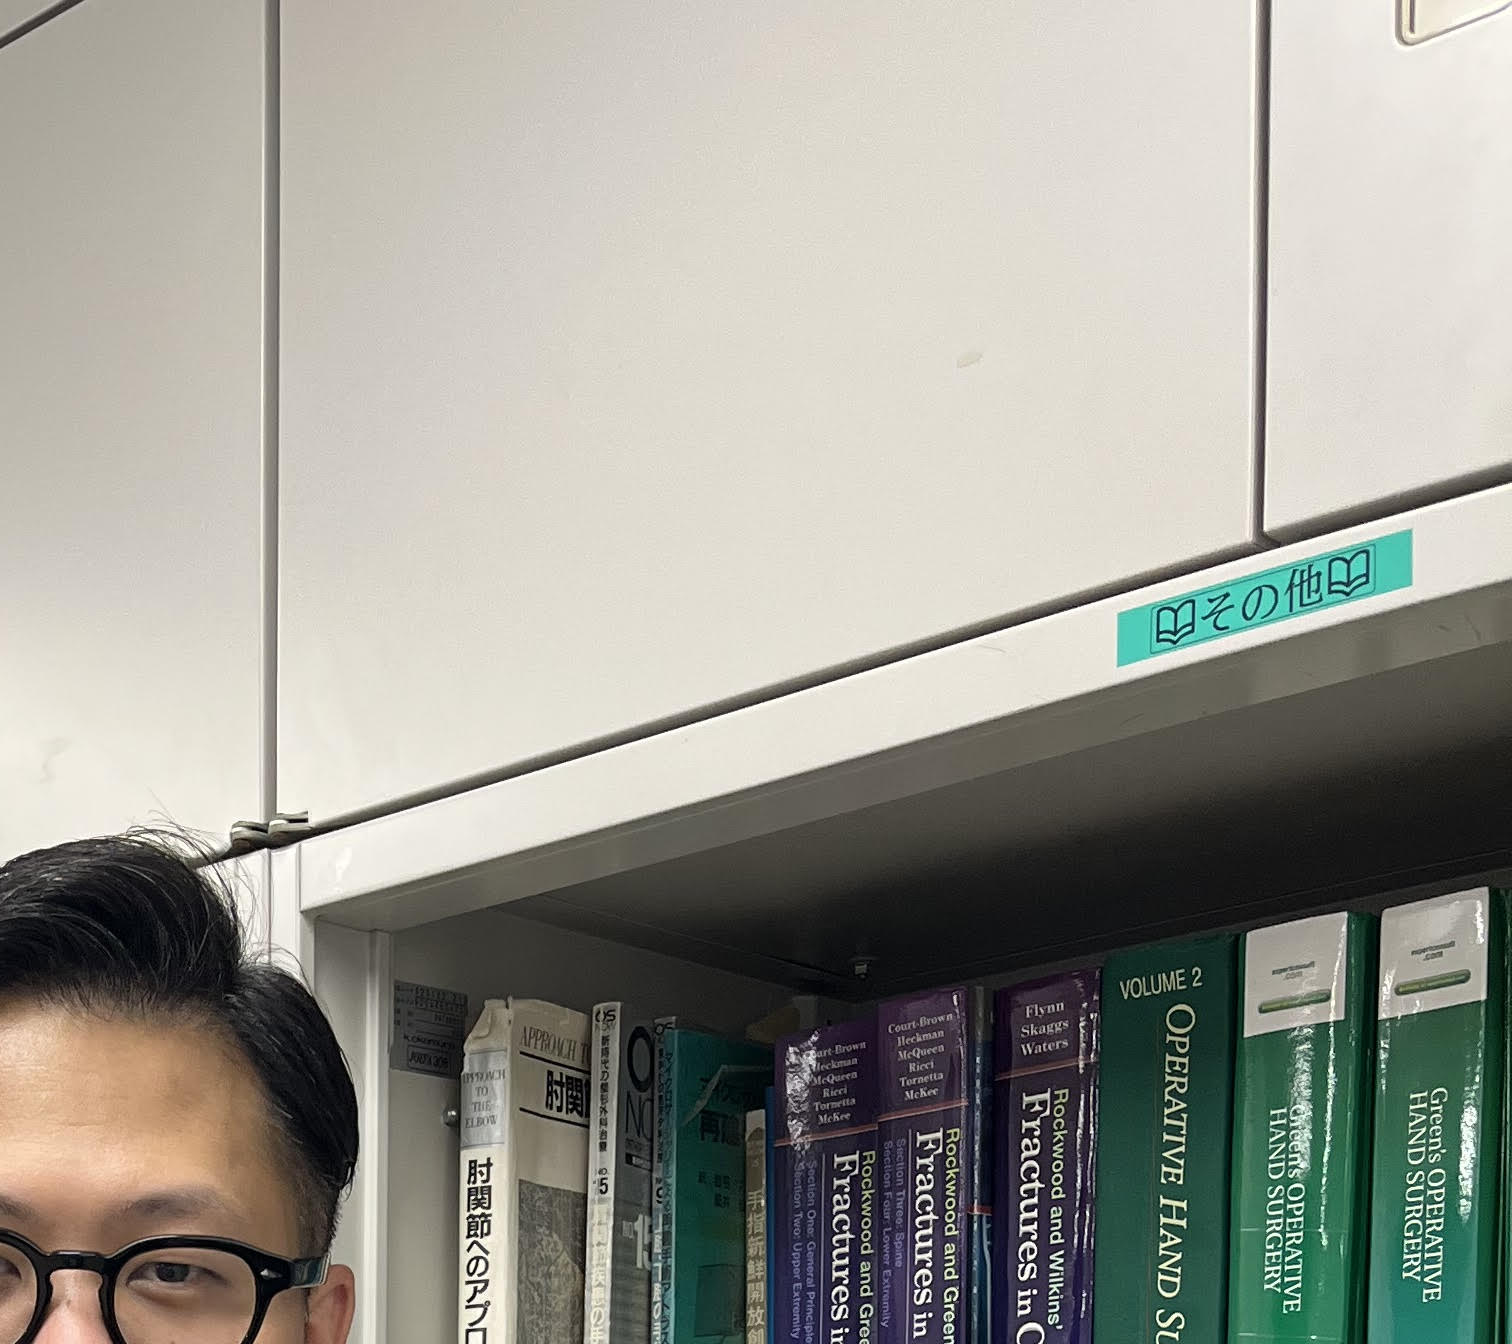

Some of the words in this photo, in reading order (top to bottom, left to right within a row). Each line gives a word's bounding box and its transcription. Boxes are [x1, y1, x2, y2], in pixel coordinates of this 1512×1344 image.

[1200, 563, 1324, 632] その他
[1119, 968, 1187, 1000] VOLUME
[1192, 966, 1203, 988] 2
[888, 1012, 953, 1034] Court-Brown
[1020, 1018, 1069, 1038] Skaggs
[1025, 1001, 1065, 1018] Flynn
[520, 1025, 576, 1062] APPROACH
[897, 1029, 944, 1048] Heckman
[897, 1044, 944, 1061] McQueen
[1020, 1037, 1069, 1057] Waters
[899, 1071, 943, 1088] Tornetta
[908, 1061, 934, 1073] Ricci
[474, 1086, 488, 1097] TO
[813, 1097, 856, 1112] Tornetta
[823, 1085, 848, 1098] Ricci
[904, 1086, 938, 1101] McKee
[1160, 1003, 1196, 1185] OPERATIVE
[465, 1115, 497, 1129] ELBOW
[817, 1111, 851, 1125] McKee
[1406, 1090, 1429, 1165] HAND
[1428, 1087, 1448, 1164] Green's
[1050, 1088, 1069, 1200] Rockwood
[1267, 1107, 1288, 1180] HAND
[944, 1127, 961, 1237] Rockwood
[1017, 1088, 1051, 1283] Fractures
[860, 1151, 876, 1255] Rockwood
[913, 1127, 943, 1306] Fractures
[830, 1150, 859, 1321] Fractures
[1049, 1206, 1065, 1245] and
[1264, 1185, 1285, 1293] SURGERY
[1402, 1170, 1425, 1282] SURGERY
[1422, 1168, 1446, 1303] OPERATIVE
[791, 1242, 803, 1280] Upper
[805, 1241, 816, 1288] General
[943, 1242, 959, 1281] and
[1157, 1194, 1188, 1298] HAND
[1282, 1183, 1306, 1313] OPERATIVE
[859, 1261, 874, 1297] and
[1048, 1252, 1065, 1330] Wilkins'
[790, 1283, 802, 1339] Extremity
[1017, 1289, 1038, 1317] in
[913, 1312, 933, 1338] in
